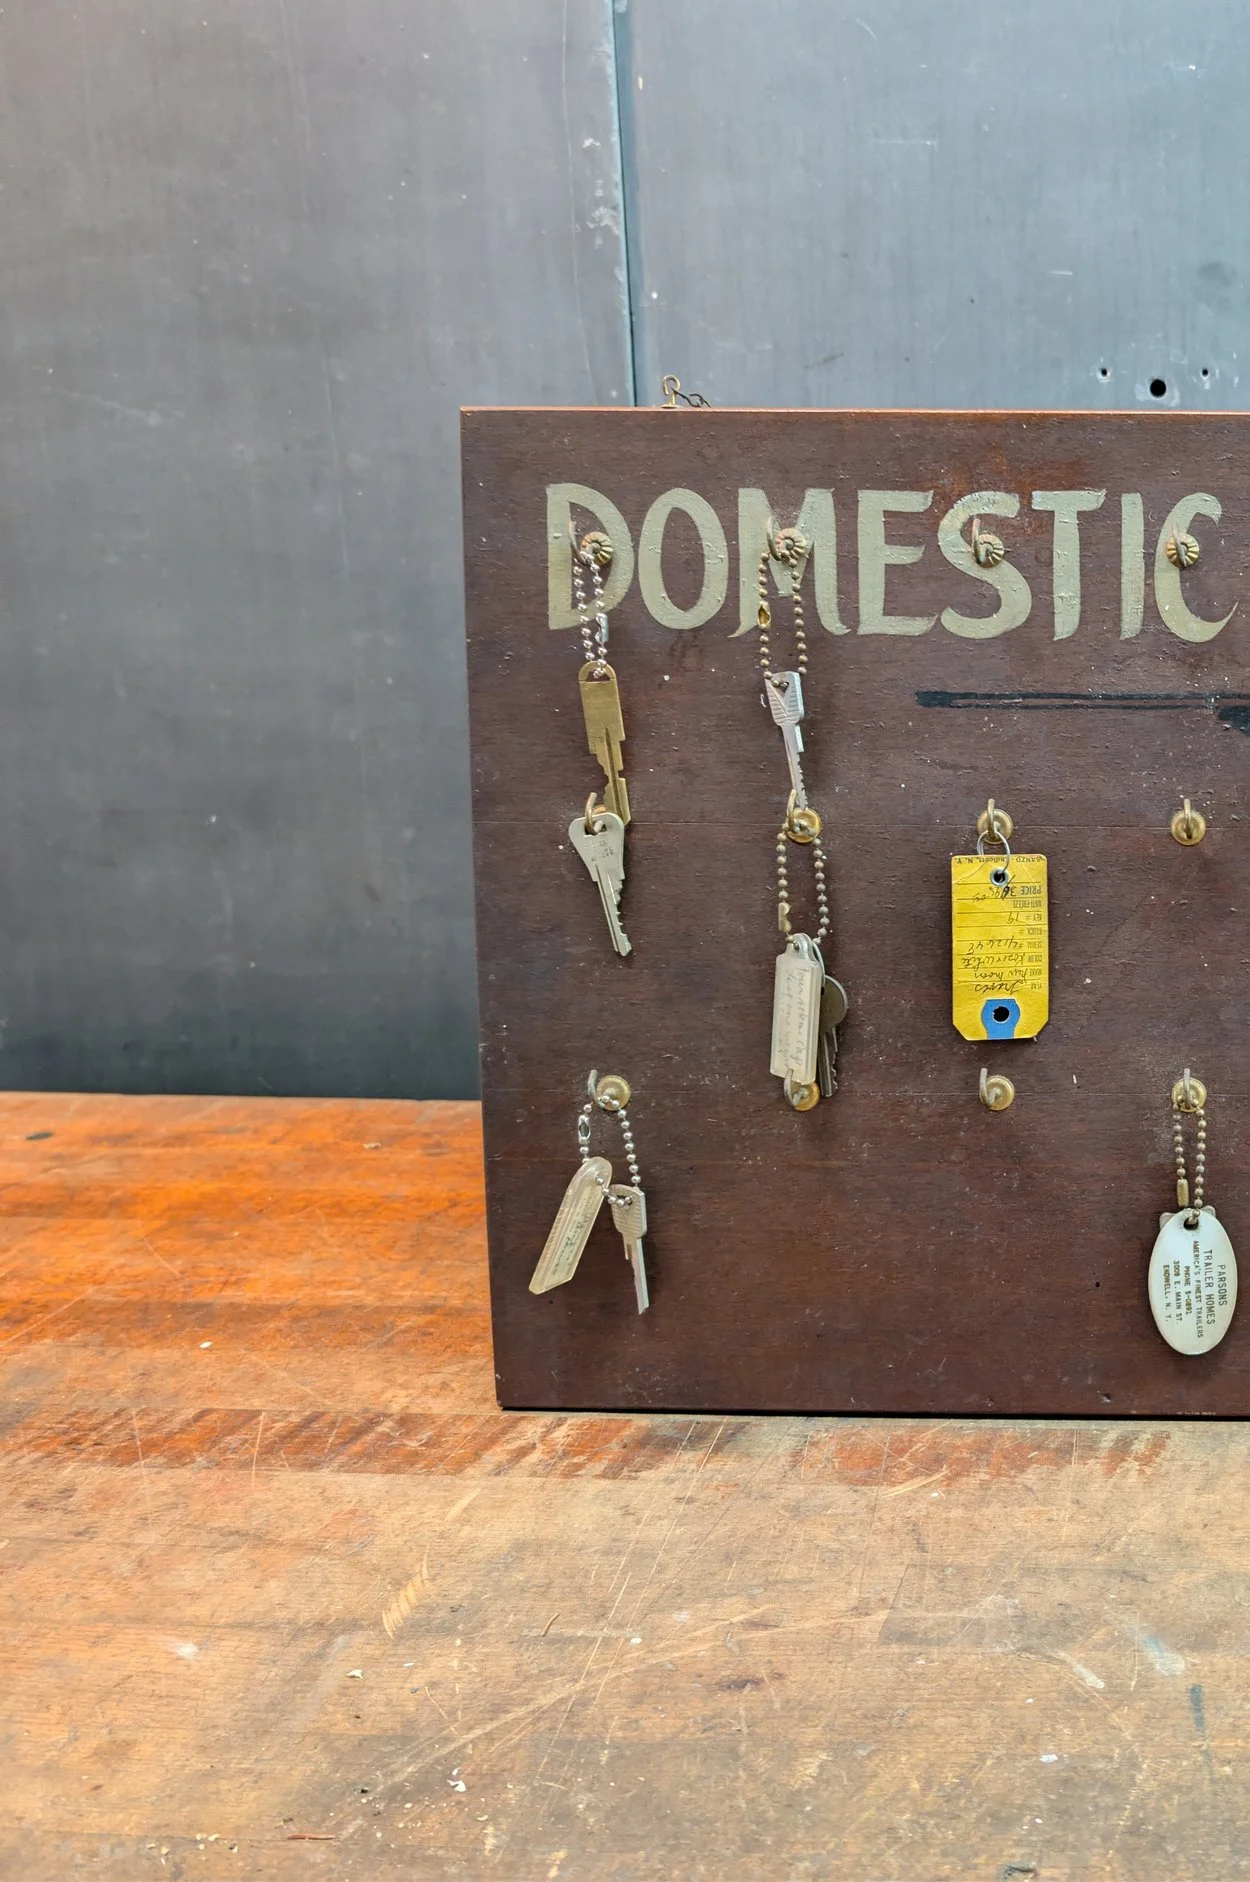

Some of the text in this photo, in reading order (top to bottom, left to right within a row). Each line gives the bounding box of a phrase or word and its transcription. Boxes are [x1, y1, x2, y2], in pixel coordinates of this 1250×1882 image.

[546, 482, 1239, 643] DOMESTIC
[1020, 885, 1042, 895] PRICE
[1163, 1264, 1171, 1299] ENDWELL,
[1174, 1281, 1181, 1289] E.
[1193, 1241, 1204, 1338] AMERICA'S FINEST TRAILERS
[1204, 1249, 1215, 1325] TRAILER HOMES
[1217, 1264, 1227, 1306] PARSONS
